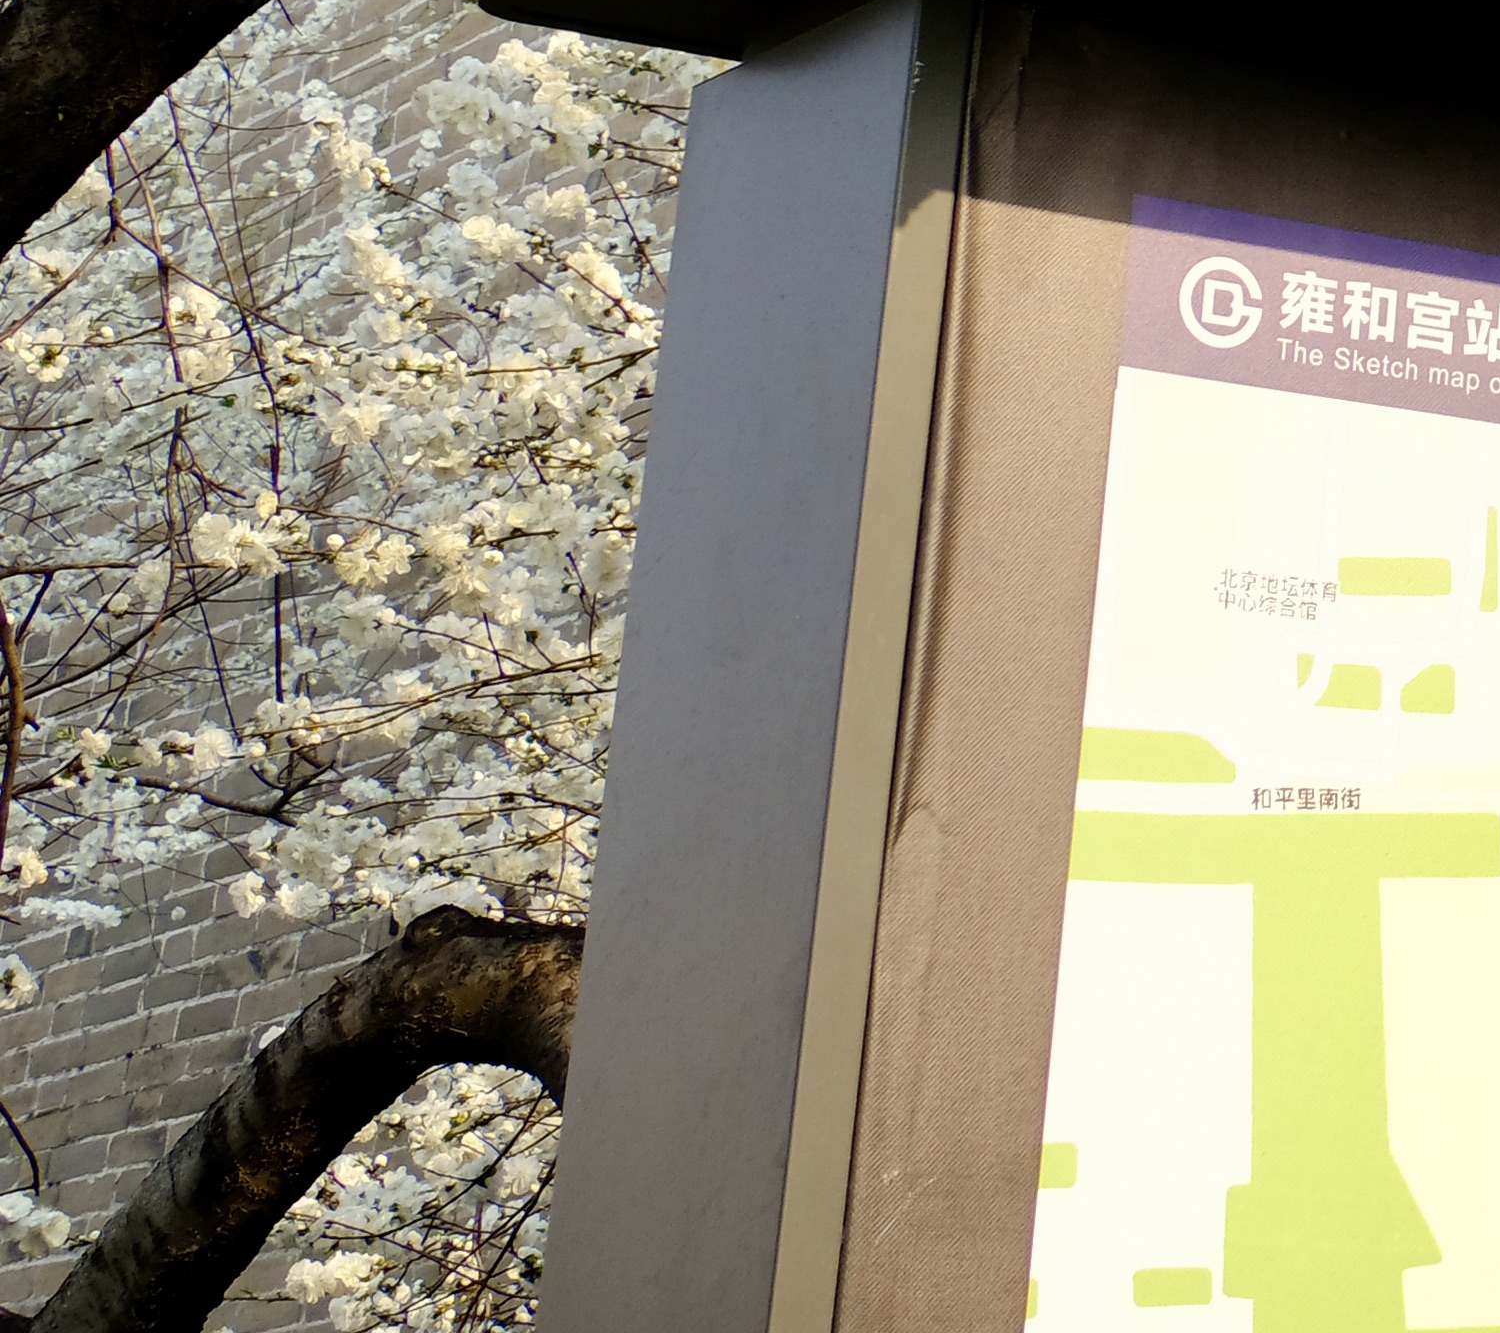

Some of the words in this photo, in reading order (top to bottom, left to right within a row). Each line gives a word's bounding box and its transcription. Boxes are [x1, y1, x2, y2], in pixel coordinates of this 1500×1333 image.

[1276, 337, 1324, 368] The
[1333, 345, 1421, 382] Sketch
[1427, 363, 1481, 396] map
[1219, 568, 1338, 603] 北京地坛体育
[1251, 787, 1362, 812] 和平里南街
